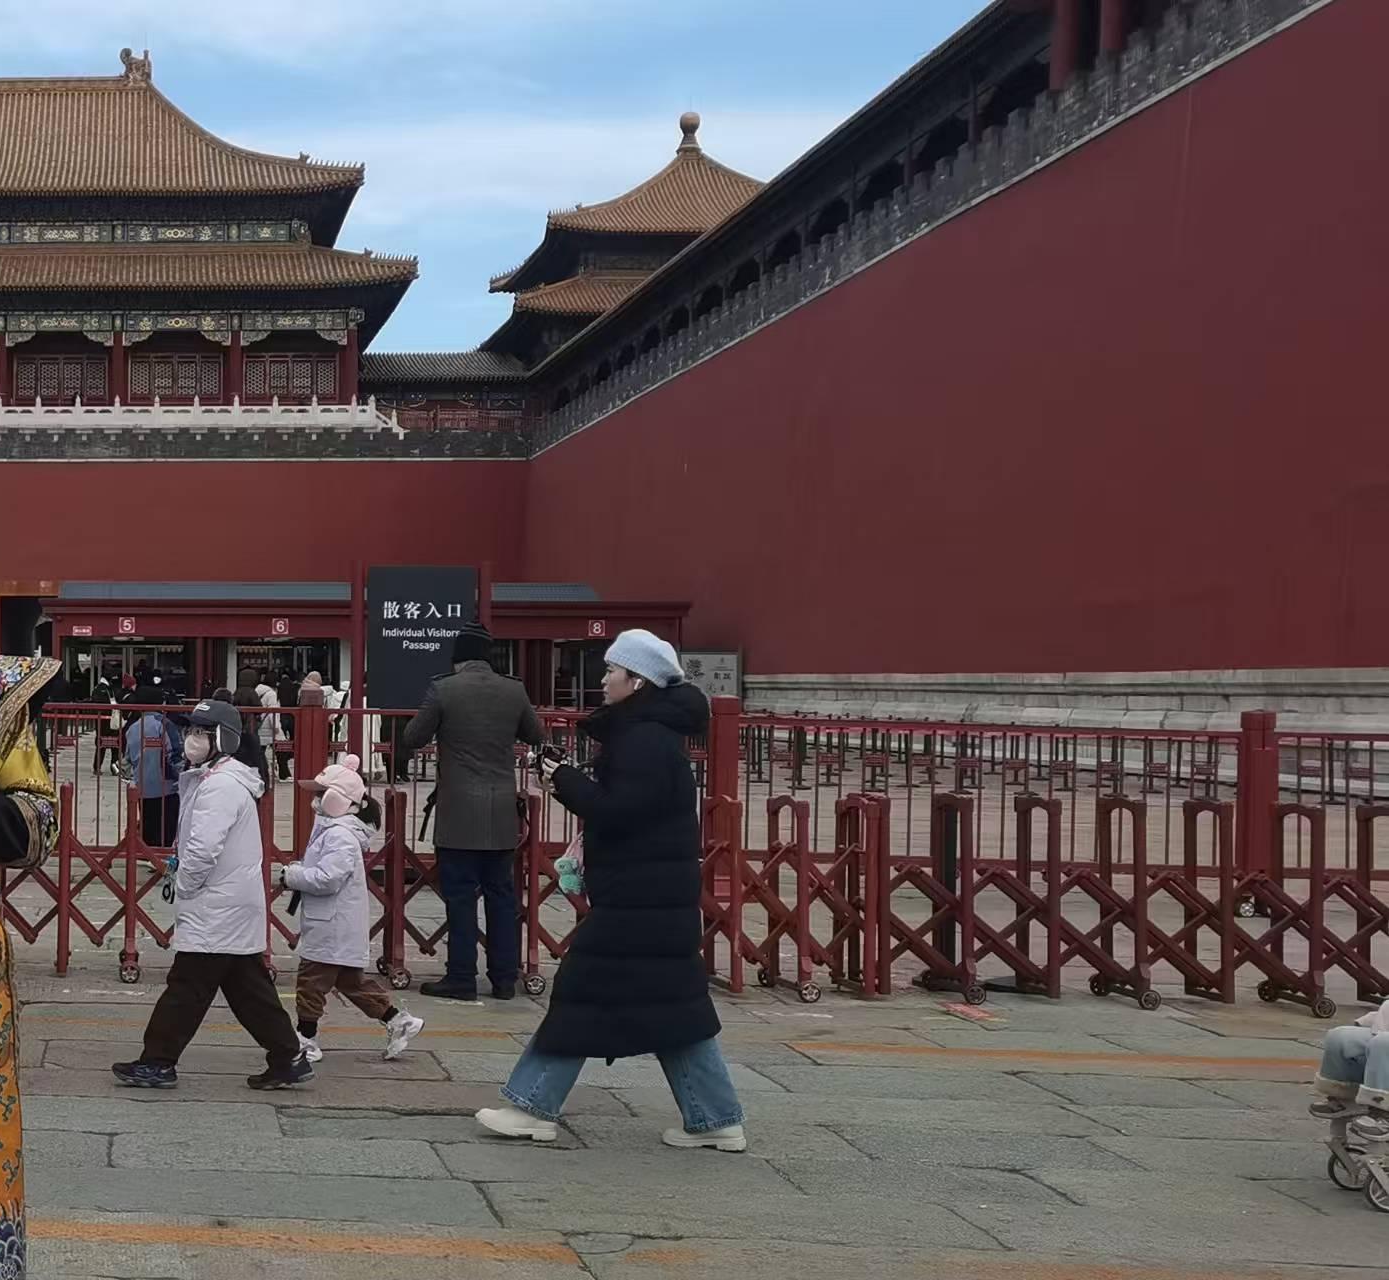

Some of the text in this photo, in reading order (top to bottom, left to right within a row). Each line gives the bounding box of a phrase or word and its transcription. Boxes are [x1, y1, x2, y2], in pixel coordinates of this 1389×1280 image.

[383, 601, 461, 619] 散客入口
[122, 619, 132, 631] 5
[276, 620, 285, 632] 6
[592, 622, 602, 634] 8
[382, 627, 426, 637] Individual
[402, 640, 441, 652] Passage
